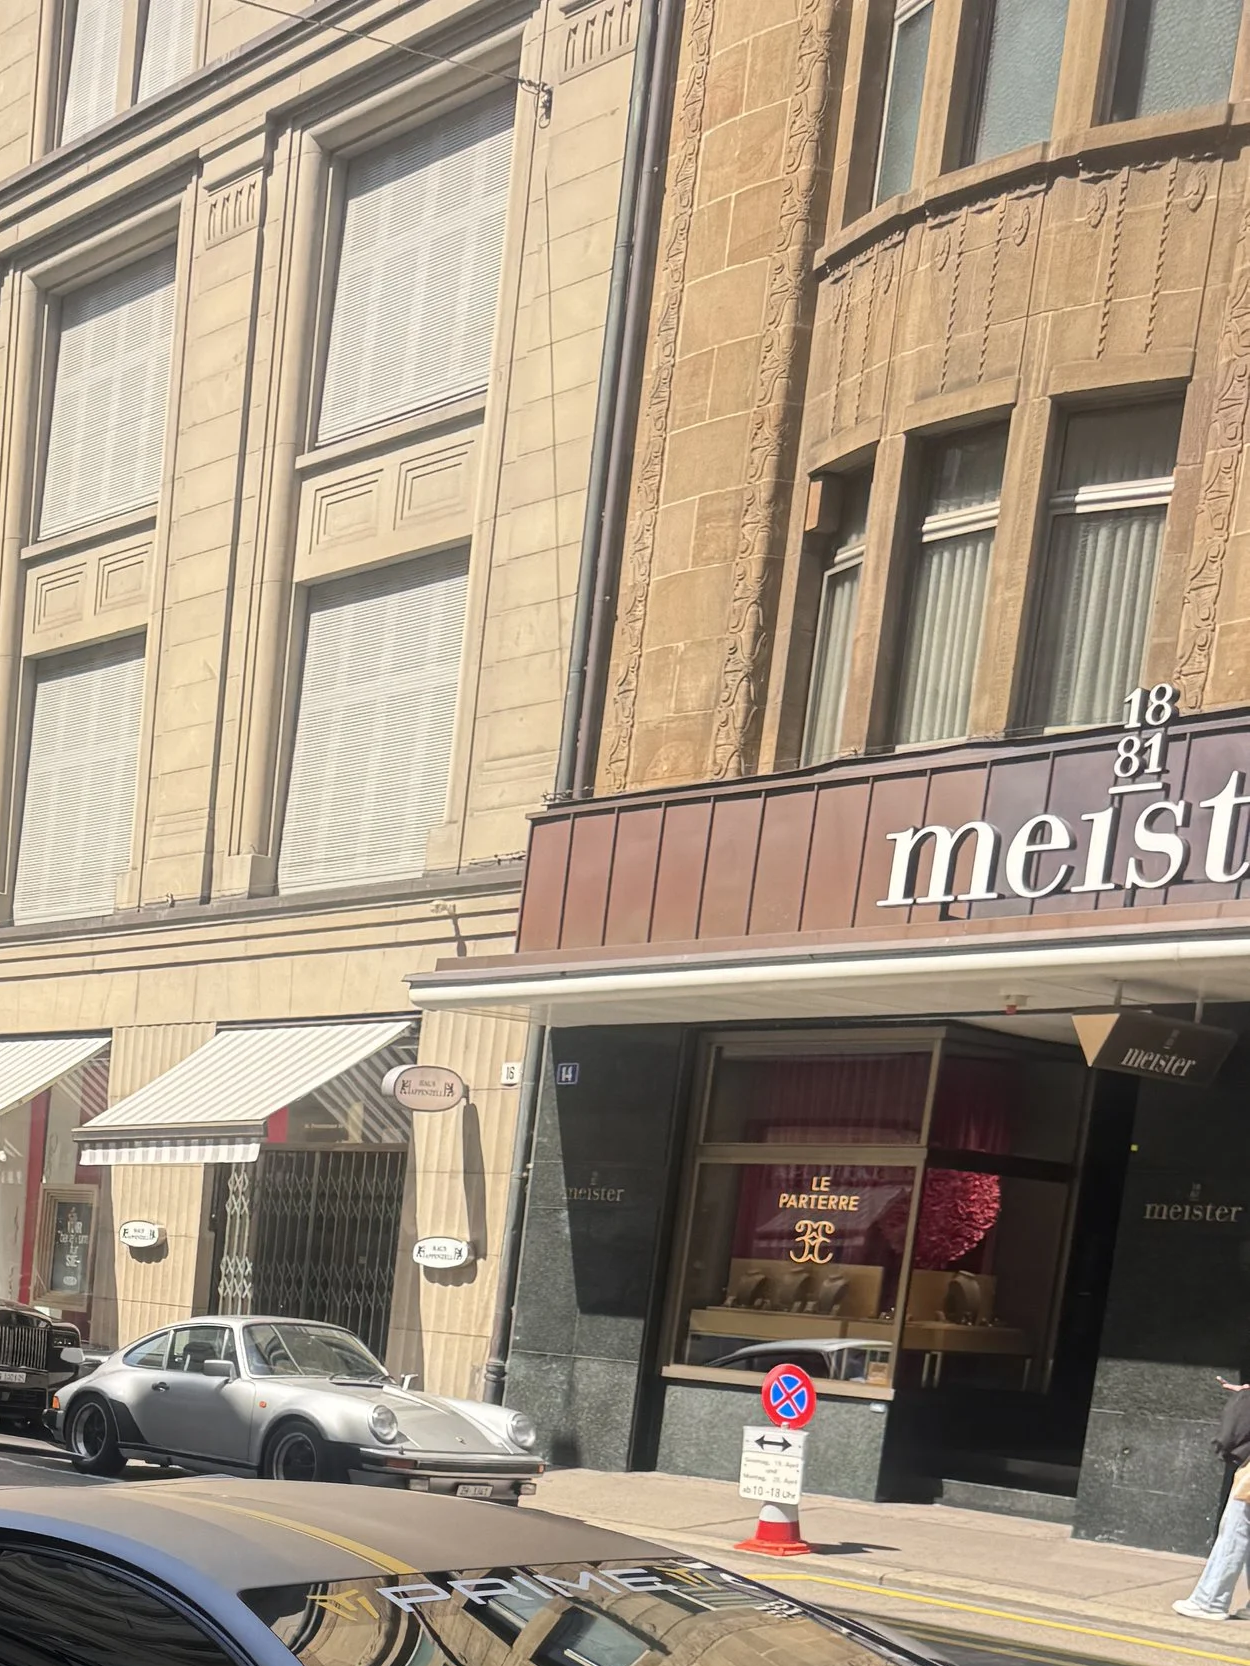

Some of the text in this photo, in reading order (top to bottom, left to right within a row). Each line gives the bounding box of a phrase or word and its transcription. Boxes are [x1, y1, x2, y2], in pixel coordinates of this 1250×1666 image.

[1124, 683, 1177, 729] 18
[1113, 732, 1167, 778] 81
[1120, 1047, 1197, 1076] meister
[506, 1066, 516, 1080] 16
[561, 1066, 573, 1081] 14
[811, 1176, 831, 1191] LE
[778, 1193, 860, 1211] PARTERRE
[1143, 1203, 1243, 1223] meister
[375, 1568, 678, 1613] PRIME
